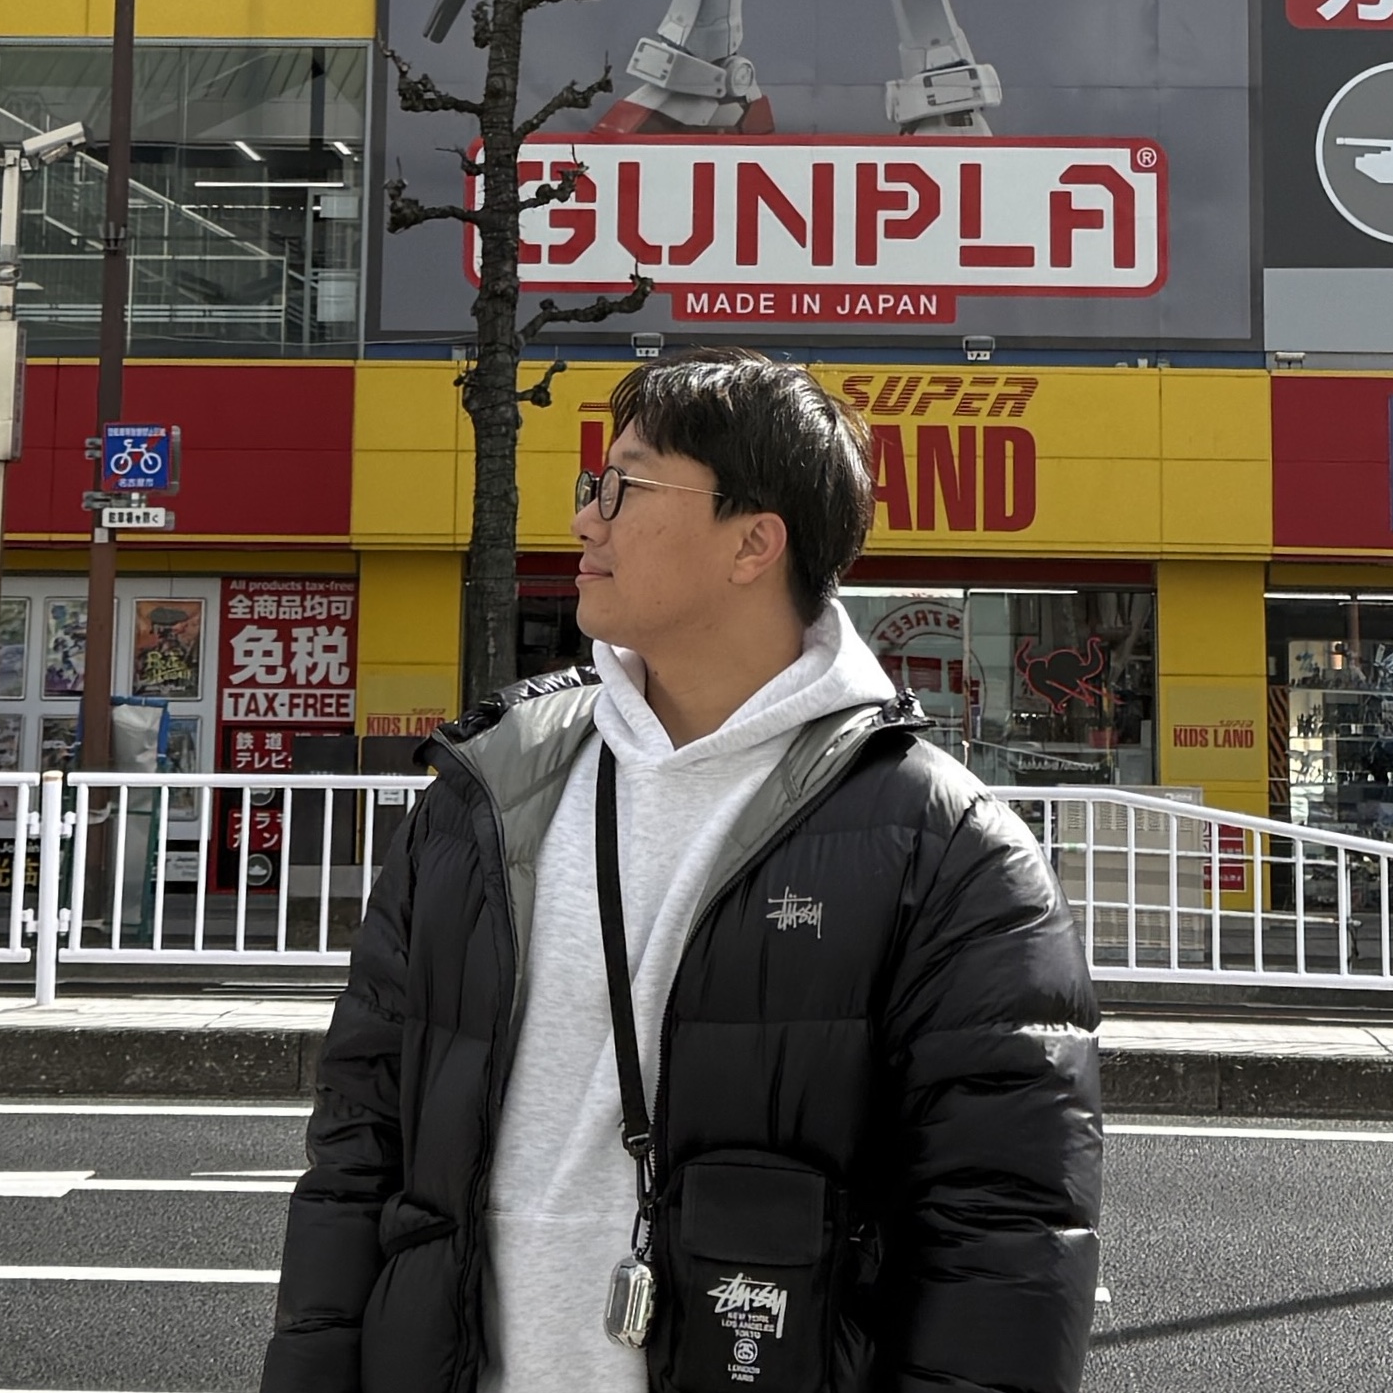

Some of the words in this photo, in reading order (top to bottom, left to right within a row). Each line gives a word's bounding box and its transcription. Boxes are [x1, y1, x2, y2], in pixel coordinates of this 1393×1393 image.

[518, 161, 1136, 269] GUNPLA
[686, 294, 775, 314] MADE
[792, 294, 822, 314] IN
[836, 295, 938, 316] JAPAN
[842, 375, 1039, 418] SUPER
[872, 424, 1036, 533] AND
[230, 581, 246, 590] All
[249, 581, 302, 593] products
[305, 581, 355, 591] tax-free
[228, 595, 355, 620] 全商品均可
[229, 625, 351, 686] 免税
[228, 693, 350, 719] TAX-FREE
[367, 716, 400, 737] KIDS
[1173, 727, 1208, 748] KIDS
[1214, 728, 1254, 748] LAND
[721, 1319, 738, 1328] LOS
